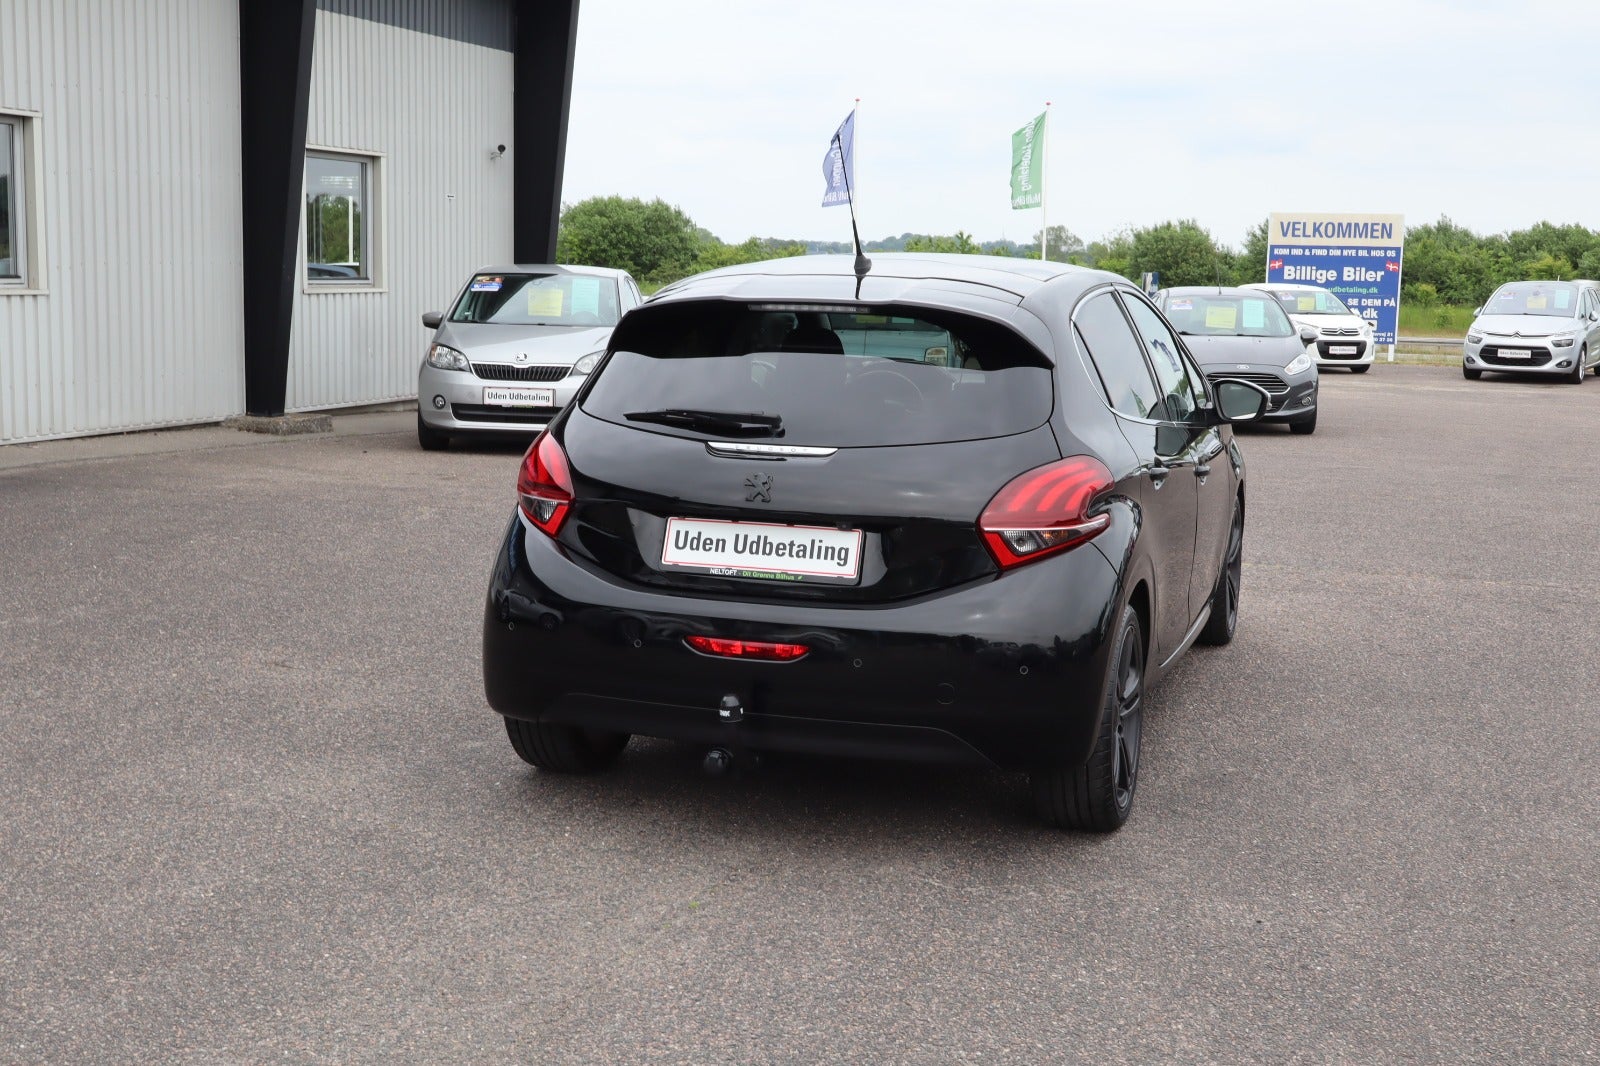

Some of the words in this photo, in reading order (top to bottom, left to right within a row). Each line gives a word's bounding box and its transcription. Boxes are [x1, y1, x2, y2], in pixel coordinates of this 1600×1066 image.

[1280, 221, 1393, 239] VELKOMMEN
[1343, 249, 1356, 257] NYE
[1284, 265, 1337, 284] Billige
[1343, 266, 1385, 282] Biler
[1347, 298, 1359, 306] SE
[1361, 298, 1381, 307] DEM
[1383, 297, 1396, 307] PÅ
[488, 391, 507, 400] Uden
[509, 392, 550, 403] Udbetaling
[674, 529, 727, 553] Uden
[733, 533, 850, 567] Udbetaling
[709, 567, 738, 577] NELTOFT
